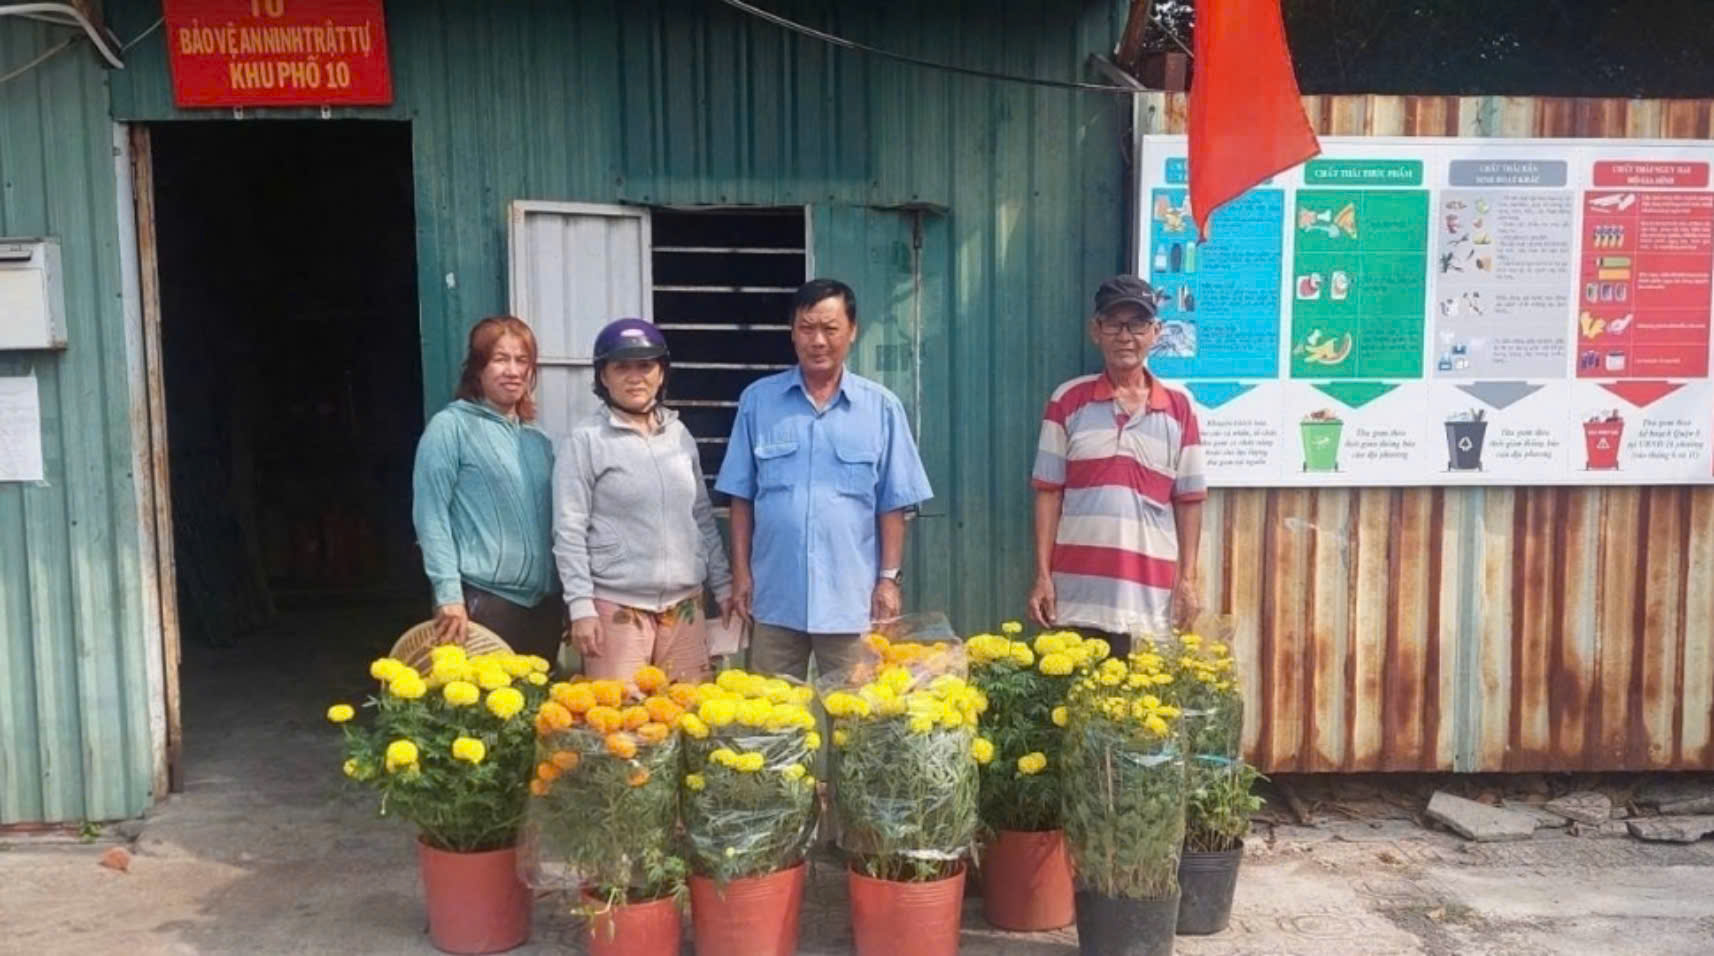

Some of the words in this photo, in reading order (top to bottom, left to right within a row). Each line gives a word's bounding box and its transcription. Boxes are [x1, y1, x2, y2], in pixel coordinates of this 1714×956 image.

[180, 18, 214, 55] BẢO
[214, 22, 239, 59] VỆ
[241, 27, 263, 54] AN
[264, 26, 304, 54] NINH
[304, 18, 346, 57] TRẬT
[347, 19, 371, 58] TỰ
[230, 62, 274, 89] KHU
[278, 54, 320, 89] PHỐ
[326, 62, 350, 89] 10
